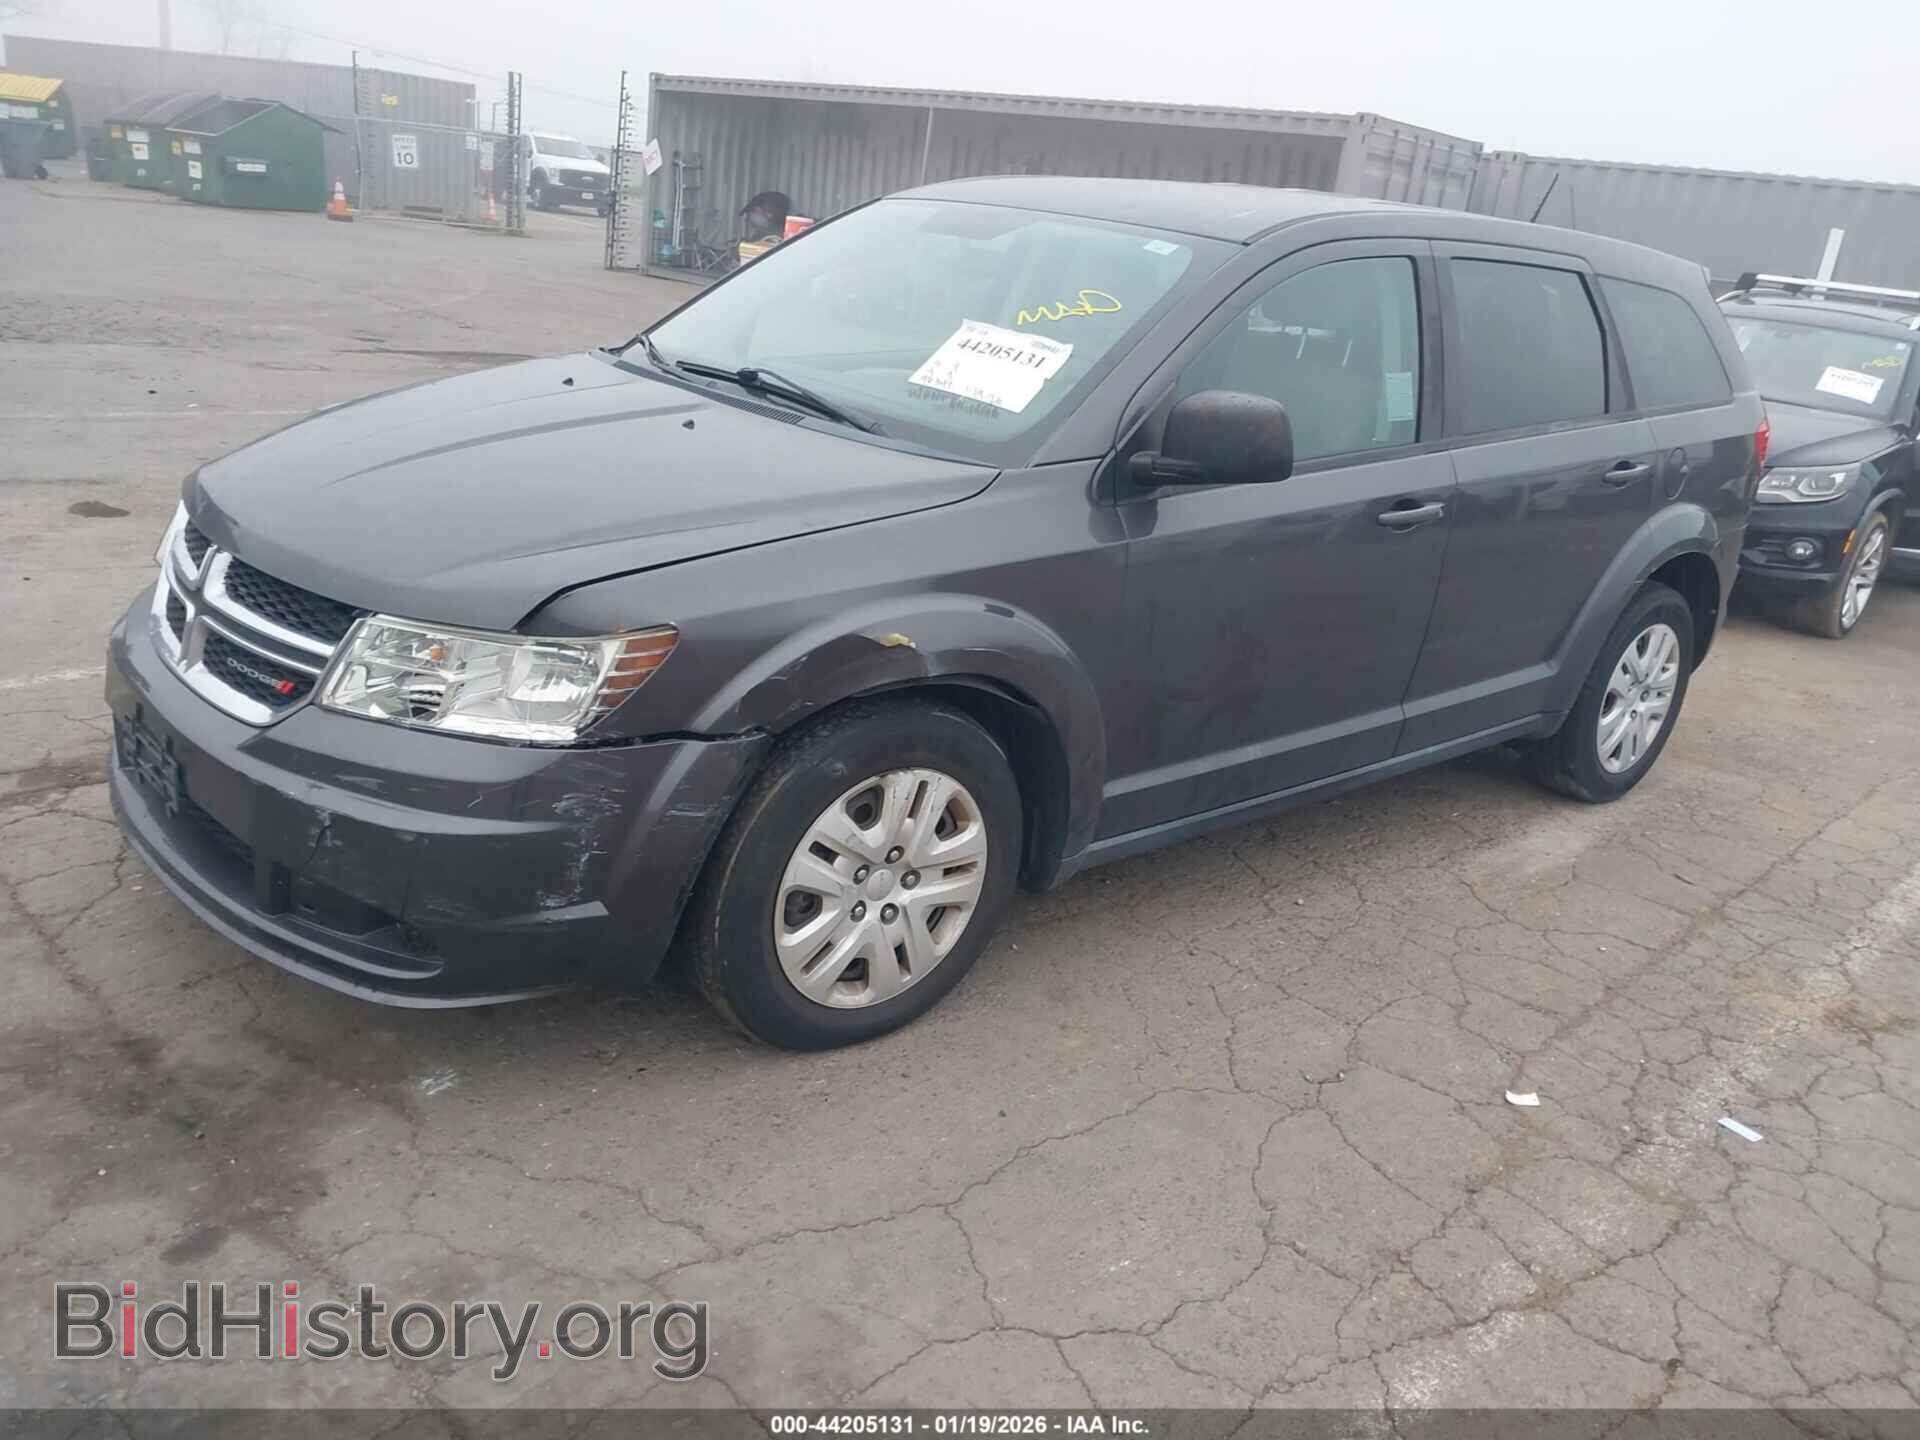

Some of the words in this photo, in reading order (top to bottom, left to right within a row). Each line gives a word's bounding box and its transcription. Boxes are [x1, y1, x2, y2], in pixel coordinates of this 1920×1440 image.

[397, 152, 414, 165] 10
[956, 338, 1047, 369] 44205131
[226, 657, 282, 689] DODGE
